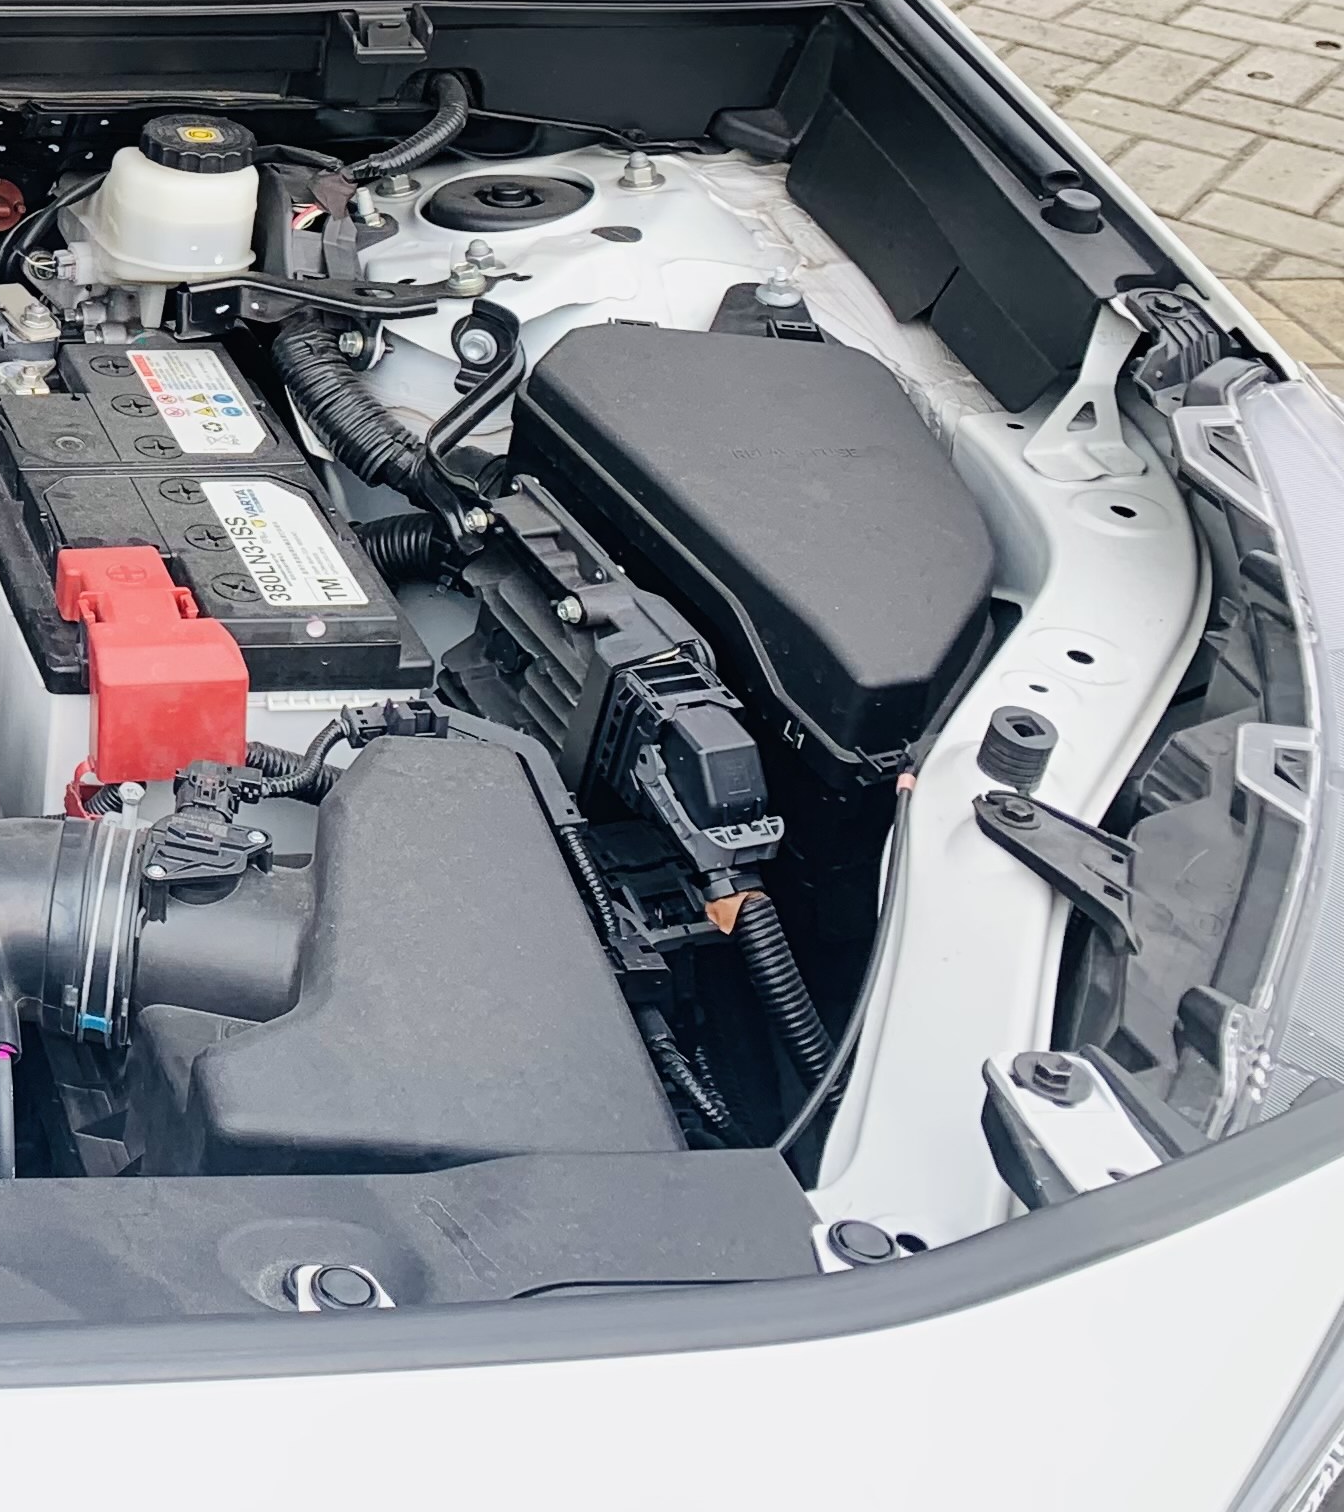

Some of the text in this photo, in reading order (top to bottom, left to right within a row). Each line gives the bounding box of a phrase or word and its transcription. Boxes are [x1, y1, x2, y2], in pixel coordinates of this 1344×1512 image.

[234, 488, 261, 518] VARTA
[224, 516, 292, 603] 380LN3-ISS
[316, 577, 348, 602] TM
[783, 719, 805, 750] L1
